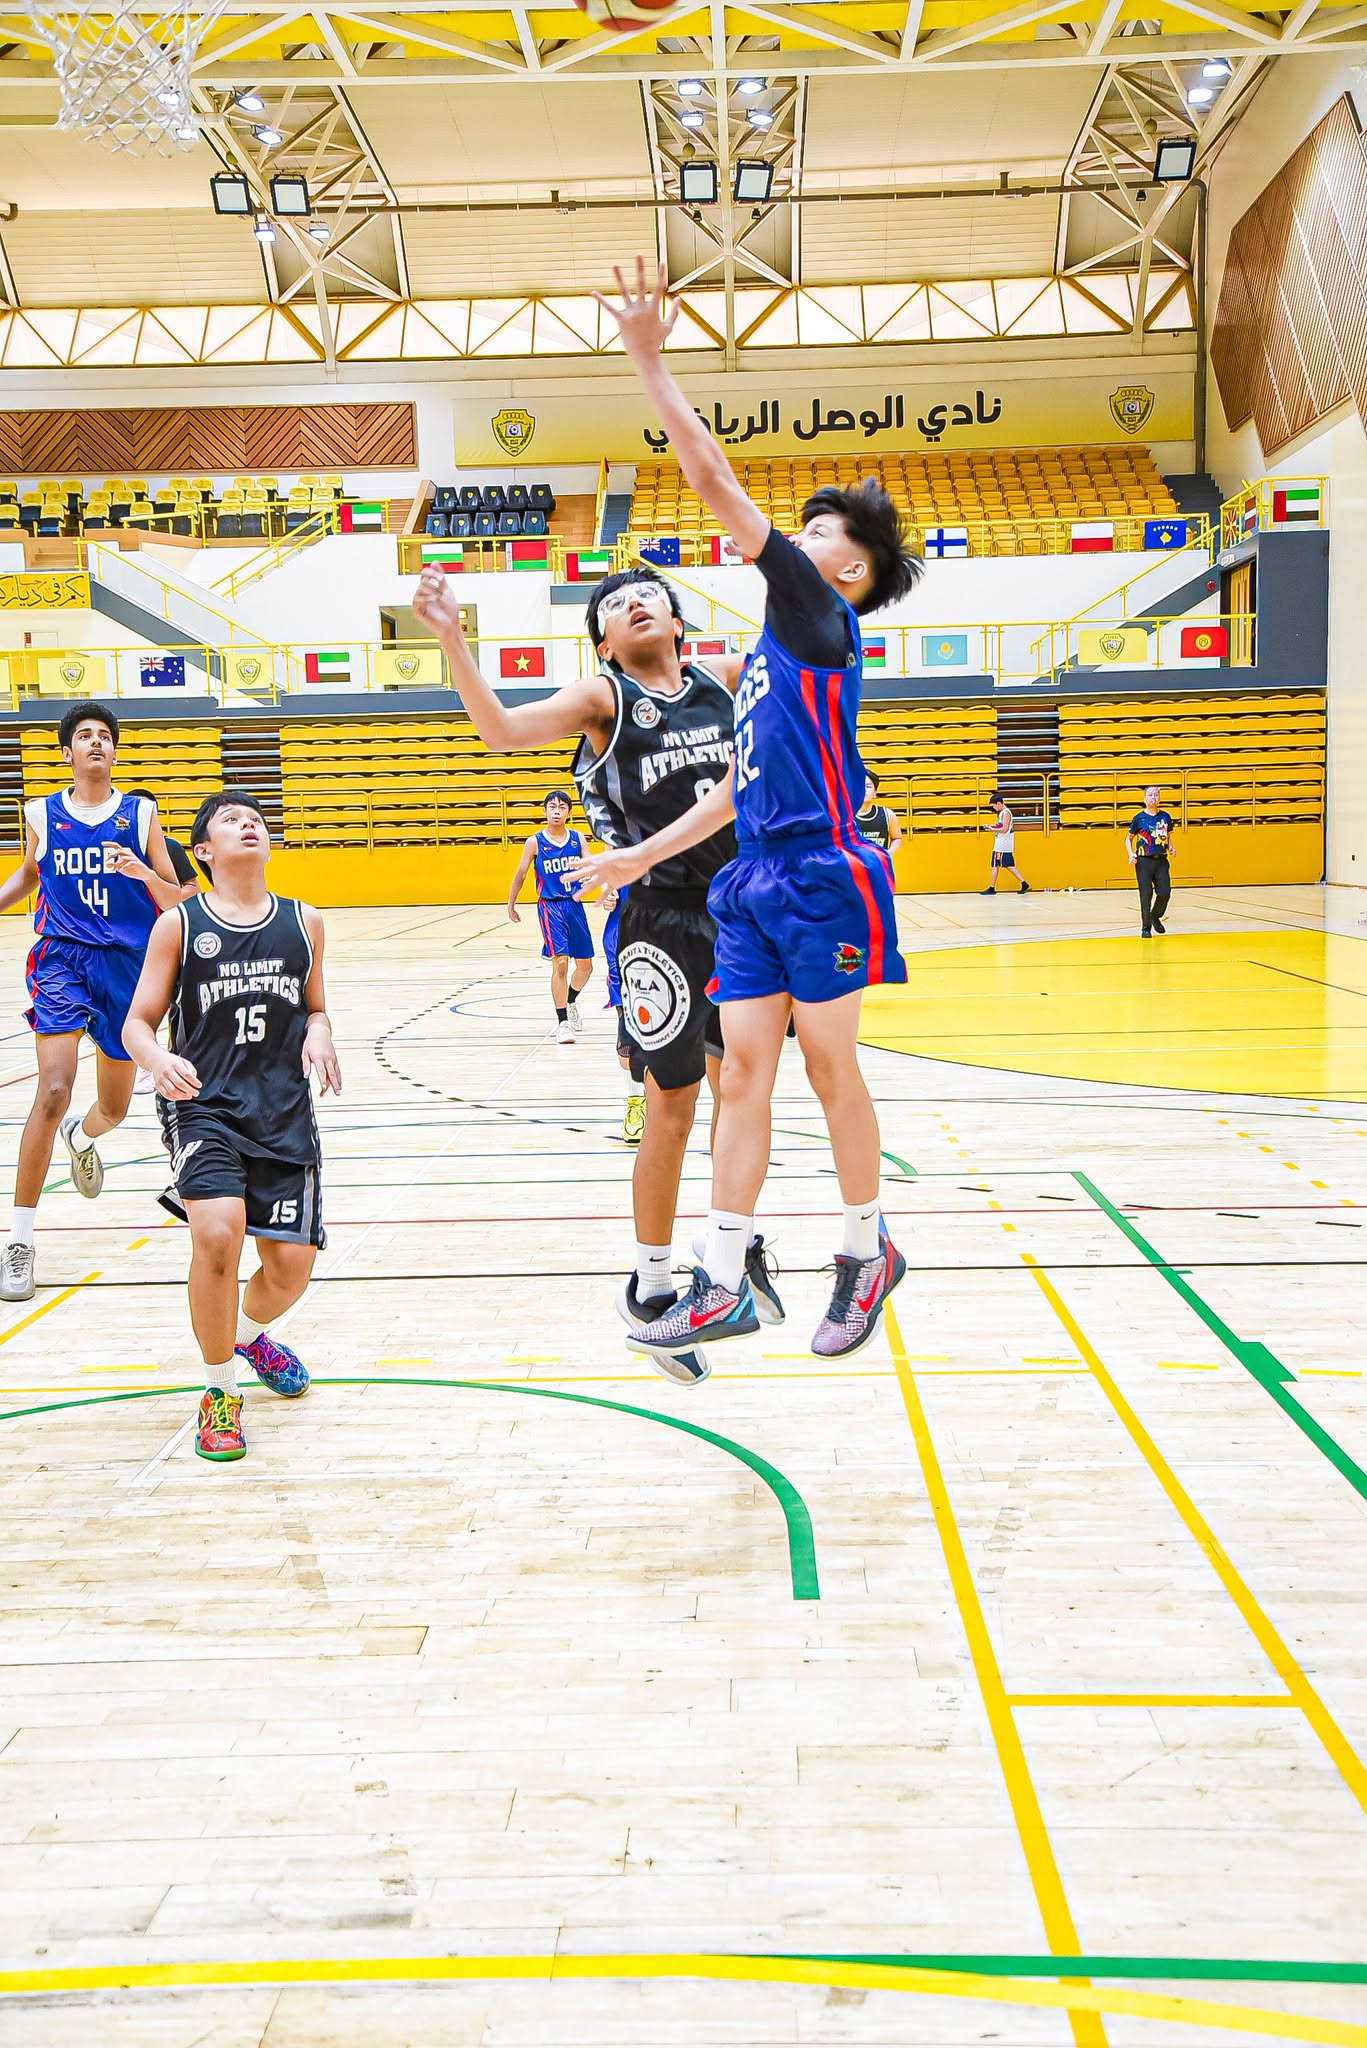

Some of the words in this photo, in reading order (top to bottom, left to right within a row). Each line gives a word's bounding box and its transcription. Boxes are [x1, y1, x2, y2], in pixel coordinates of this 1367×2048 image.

[643, 399, 780, 453] الرياي
[793, 395, 904, 440] الوصل
[917, 390, 1002, 443] نادي
[682, 725, 720, 745] LIMIT
[641, 740, 734, 792] ATHLETIC
[77, 879, 109, 917] 44
[219, 962, 241, 978] NO
[243, 960, 284, 976] LIMIT
[198, 975, 301, 1014] ATHLETICS
[235, 1004, 267, 1045] 15
[269, 1199, 298, 1225] 15
